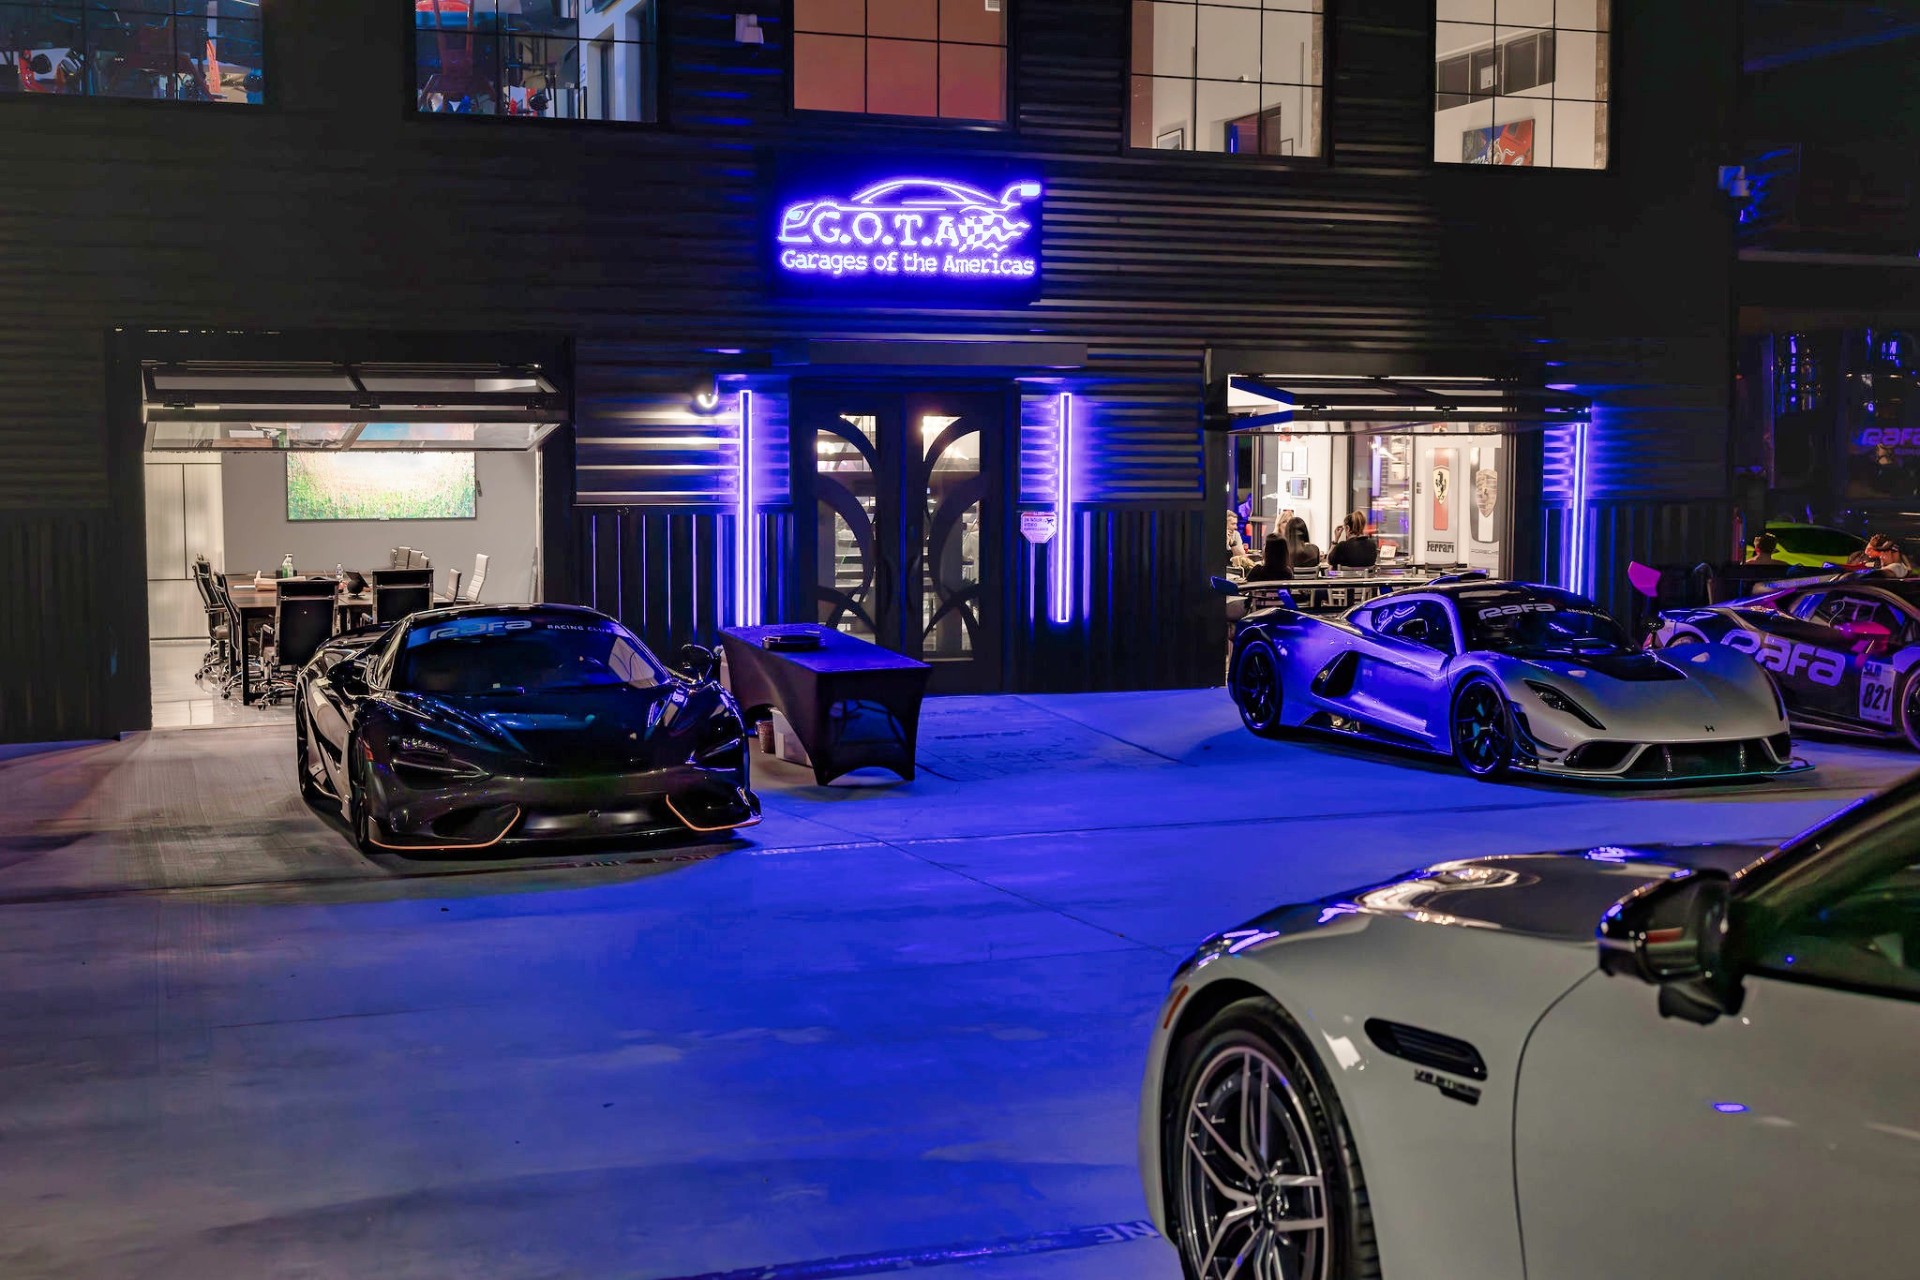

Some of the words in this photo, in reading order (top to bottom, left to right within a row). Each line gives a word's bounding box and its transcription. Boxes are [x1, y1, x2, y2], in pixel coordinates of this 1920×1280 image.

[781, 251, 868, 274] Garages
[874, 252, 898, 272] of
[903, 253, 938, 272] the
[942, 253, 1035, 275] Americas
[1426, 541, 1454, 554] Ferrari
[1863, 682, 1892, 712] 821
